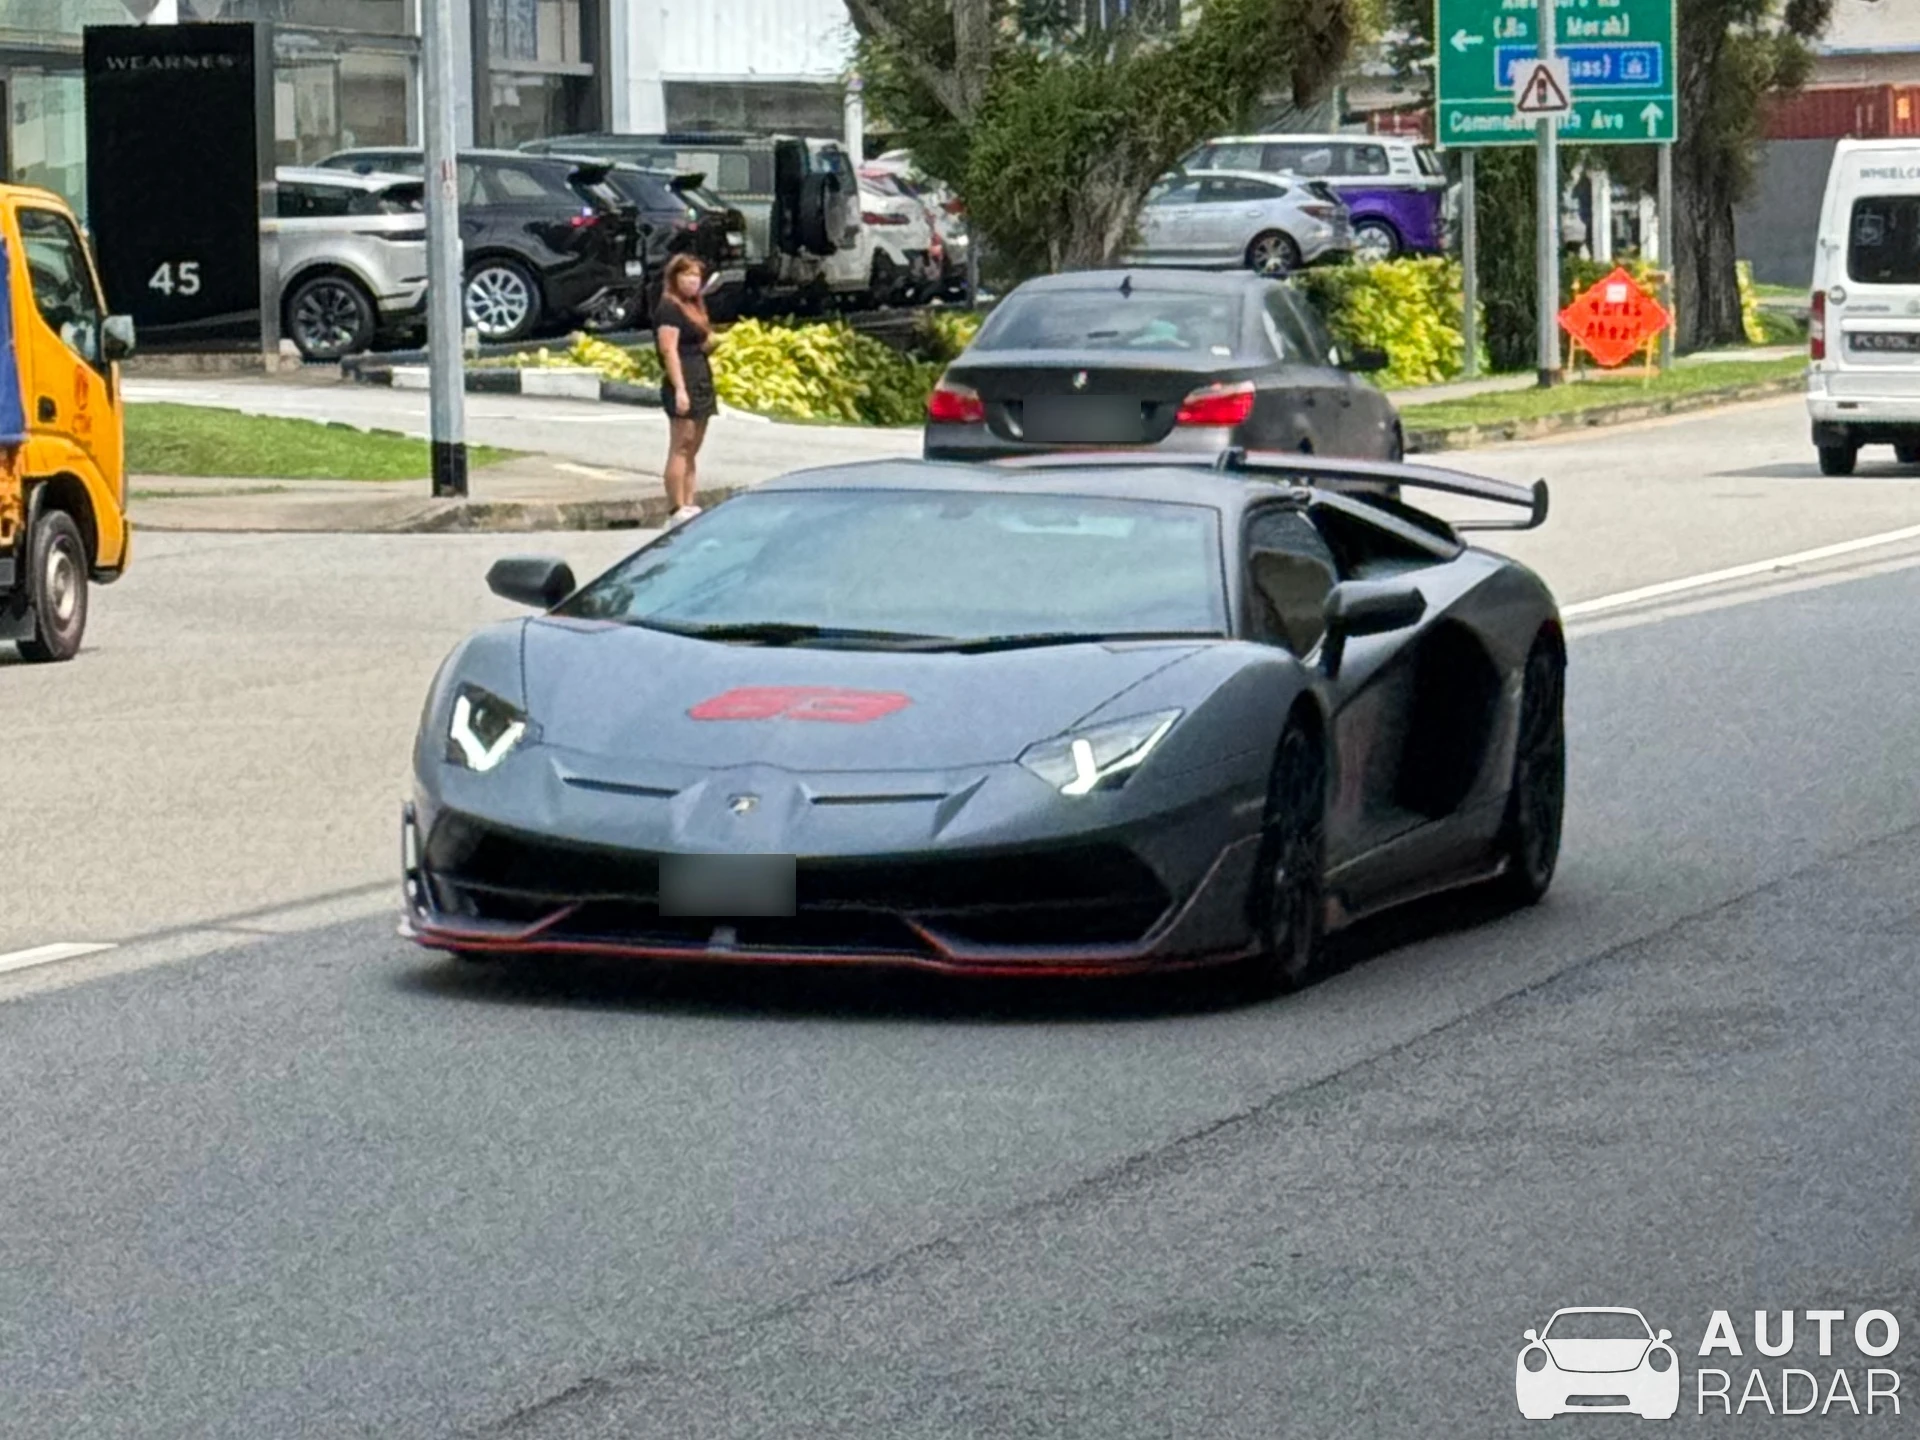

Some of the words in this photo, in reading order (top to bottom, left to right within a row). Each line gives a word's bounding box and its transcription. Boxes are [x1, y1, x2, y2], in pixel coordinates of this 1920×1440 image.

[106, 54, 235, 70] WEARNES
[1591, 108, 1624, 130] Ave
[148, 261, 201, 295] 45
